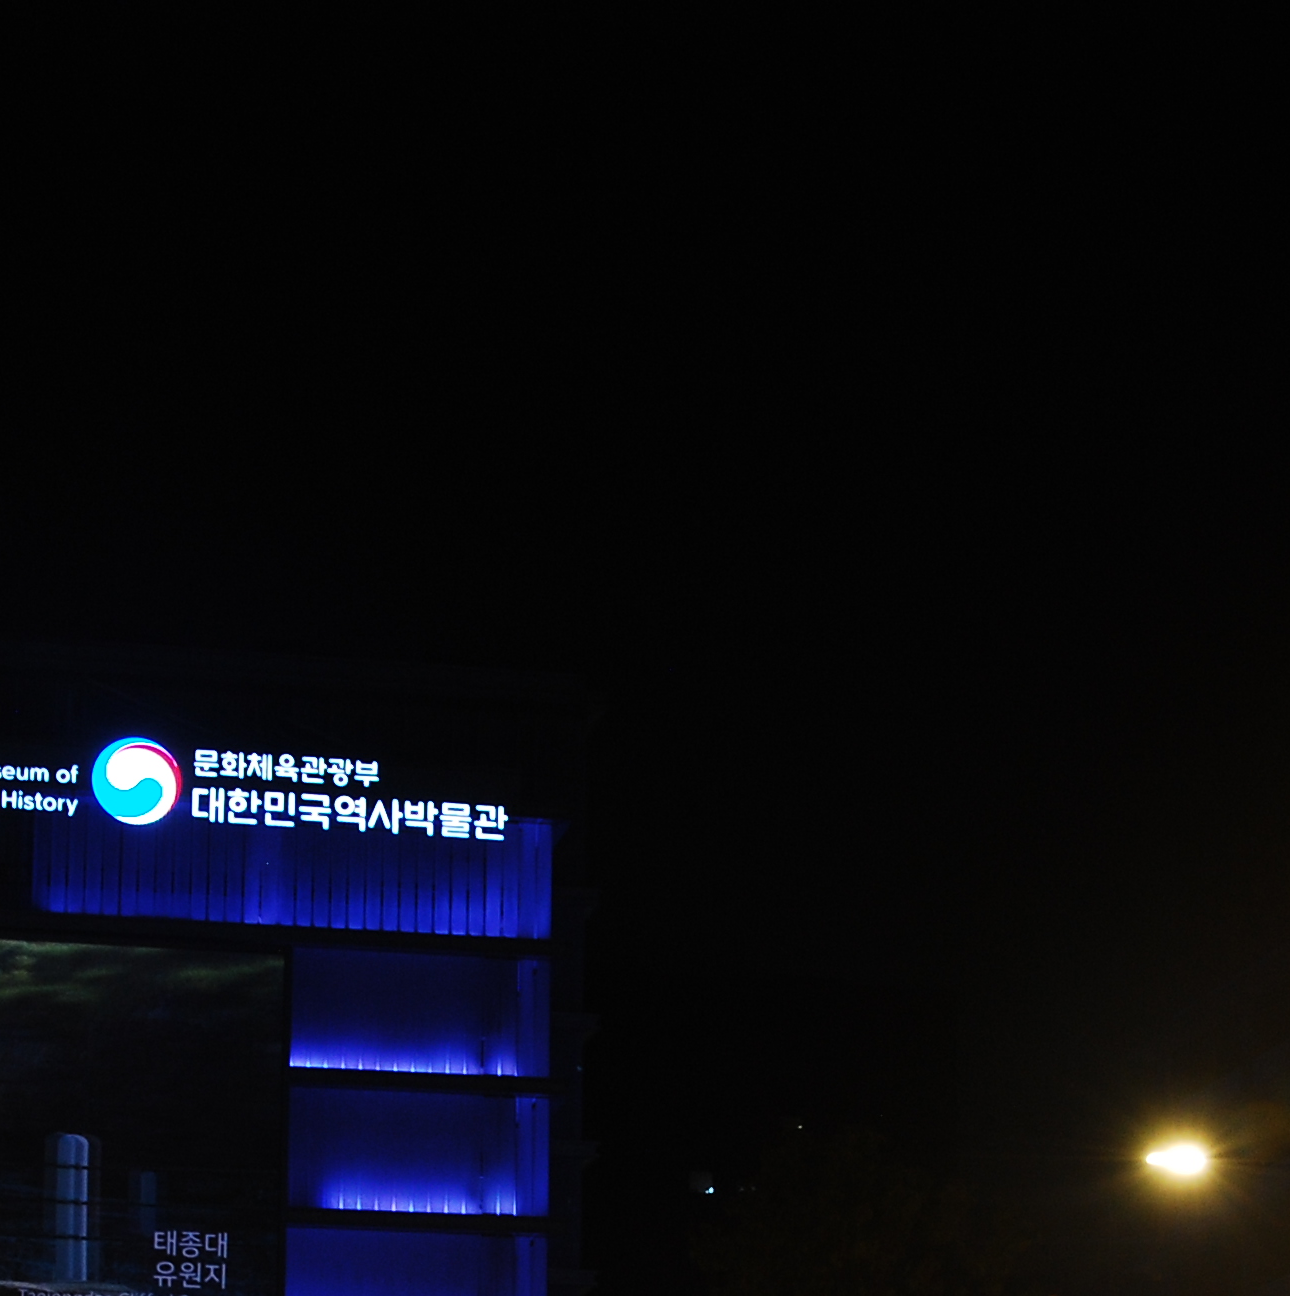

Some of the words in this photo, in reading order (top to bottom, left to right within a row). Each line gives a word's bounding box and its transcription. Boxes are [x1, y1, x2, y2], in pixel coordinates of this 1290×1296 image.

[55, 764, 79, 784] of
[193, 748, 381, 788] 문화체육관광부
[0, 790, 79, 816] History
[191, 786, 509, 842] 대한민국역사박물관
[153, 1229, 229, 1259] 태종대
[153, 1260, 227, 1290] 유원지
